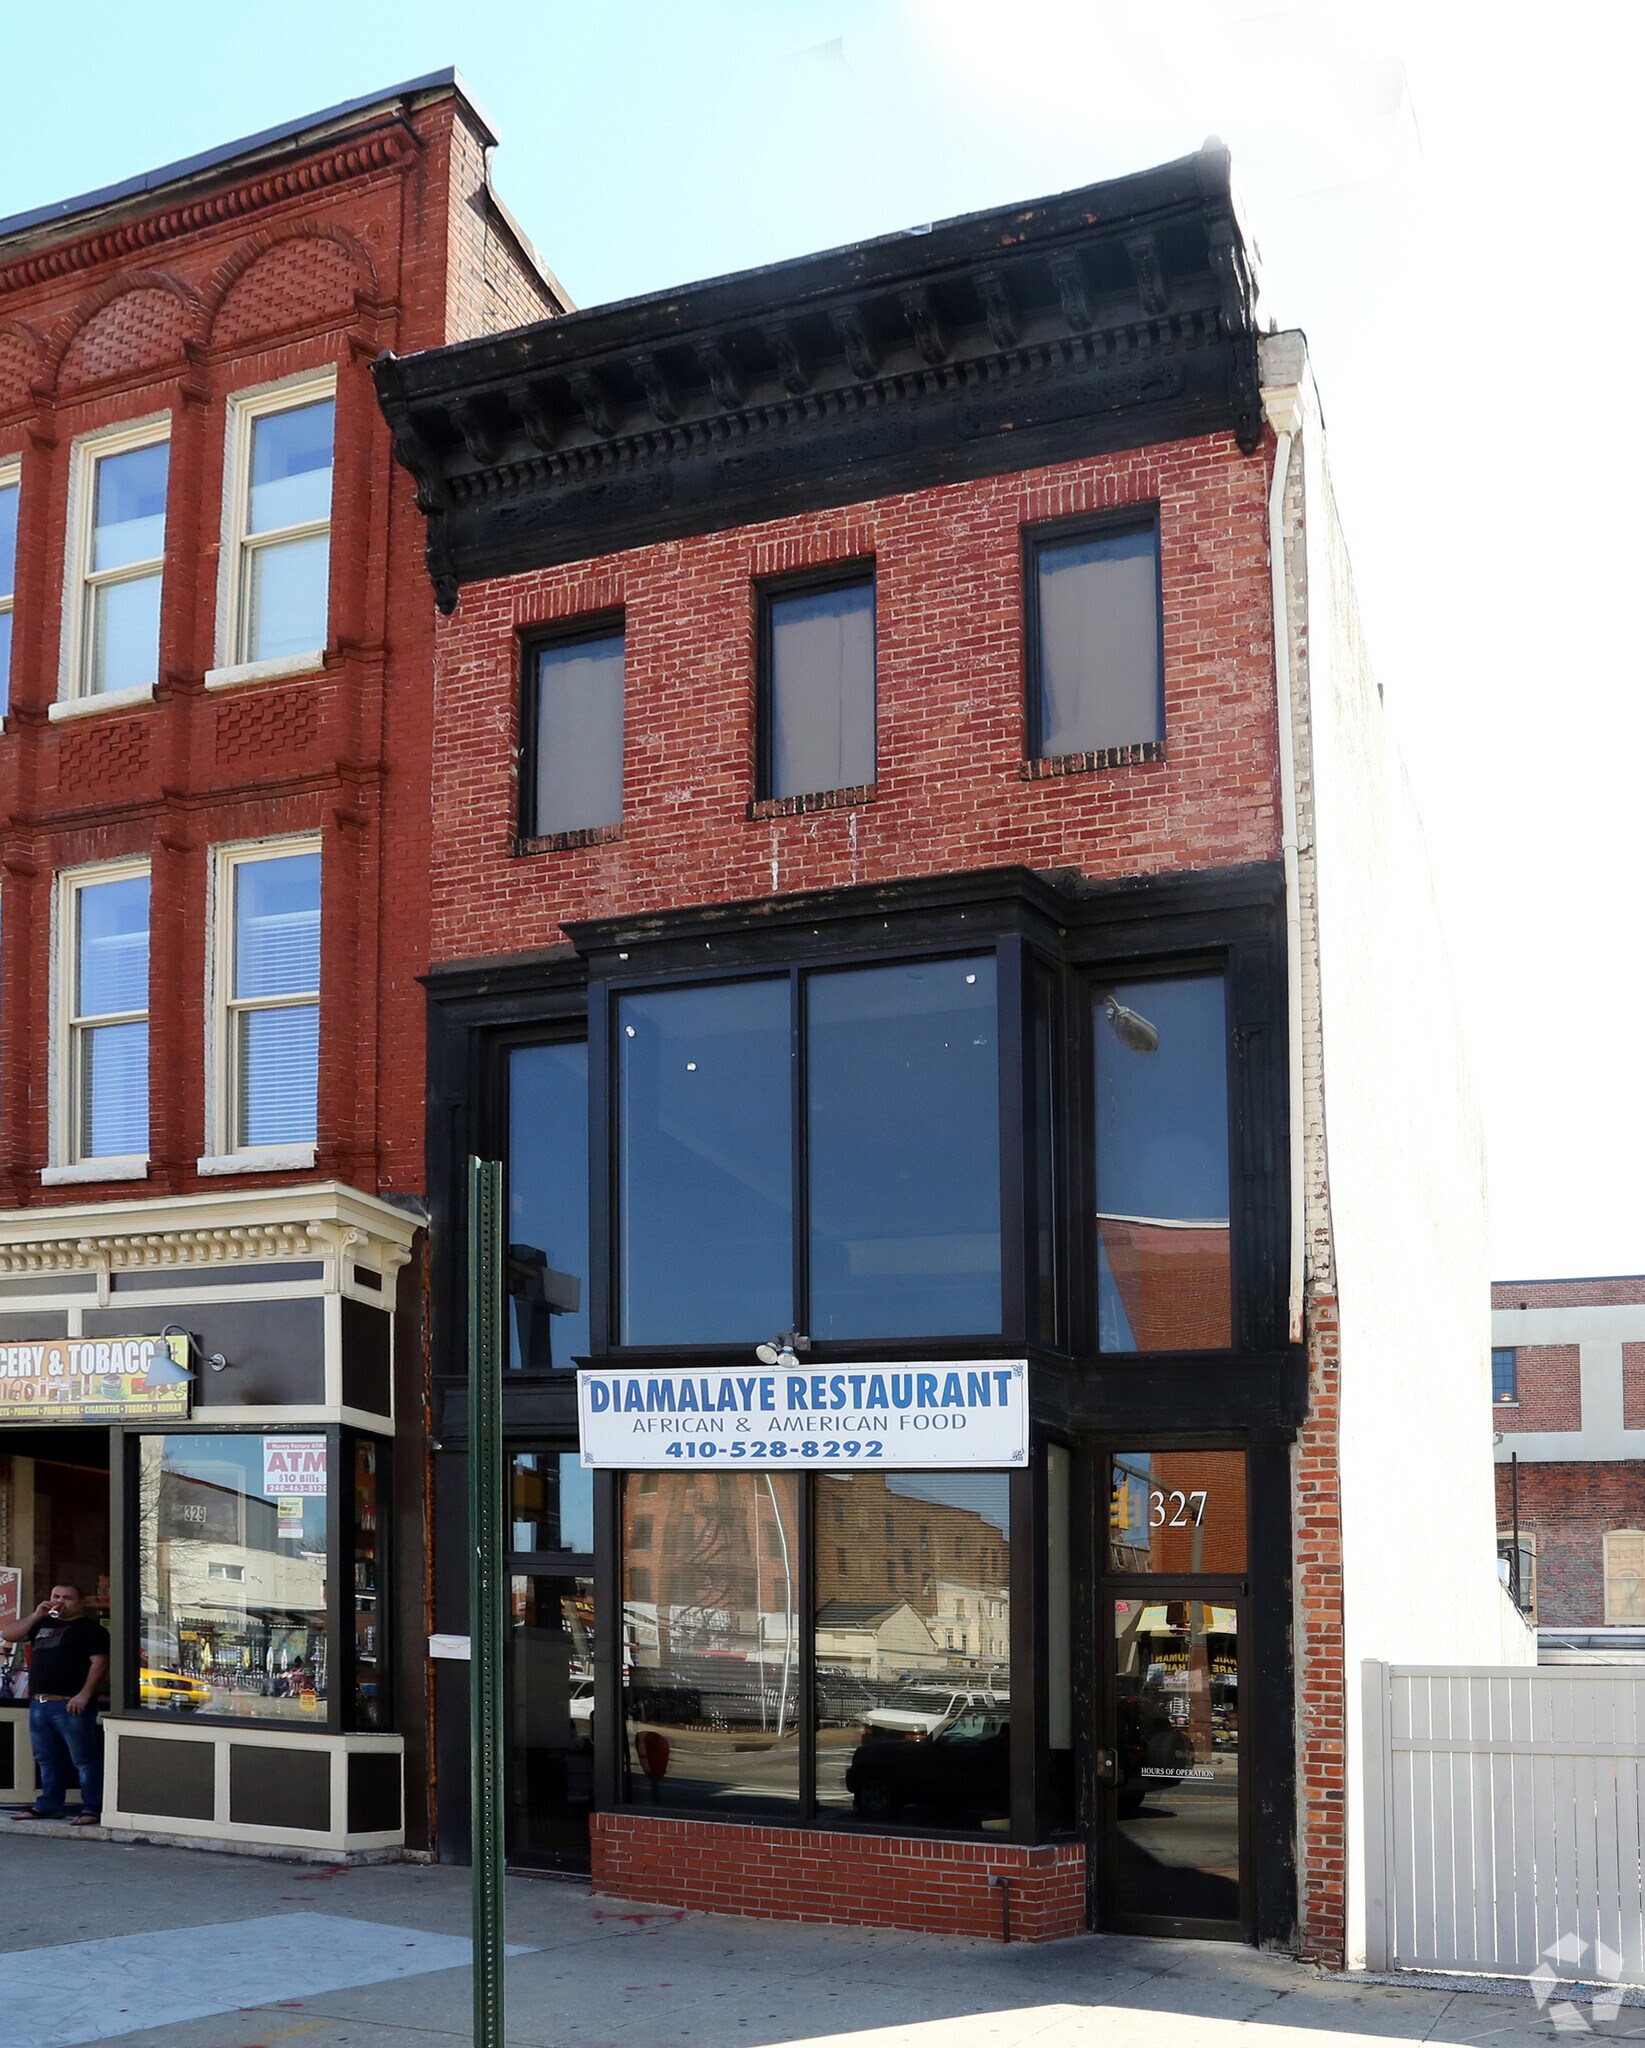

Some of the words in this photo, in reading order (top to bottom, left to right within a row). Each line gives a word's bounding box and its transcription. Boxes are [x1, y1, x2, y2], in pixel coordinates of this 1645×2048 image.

[48, 1350, 63, 1376] &
[68, 1341, 160, 1375] TOBACC
[591, 1377, 776, 1413] DIAMALAYE
[786, 1371, 1013, 1410] RESTAURANT
[632, 1416, 724, 1434] AFRICAN
[735, 1416, 752, 1433] &
[767, 1414, 889, 1433] AMERICAN
[898, 1413, 967, 1431] FOOD
[665, 1440, 883, 1458] 410-528-8292
[268, 1452, 327, 1472] ATM
[279, 1473, 296, 1483] $10
[299, 1473, 319, 1483] Bills
[185, 1506, 205, 1522] 329
[1149, 1491, 1208, 1527] 327
[1141, 1767, 1164, 1775] HOURS
[1165, 1768, 1175, 1776] OF
[1176, 1768, 1214, 1778] OPERATION
